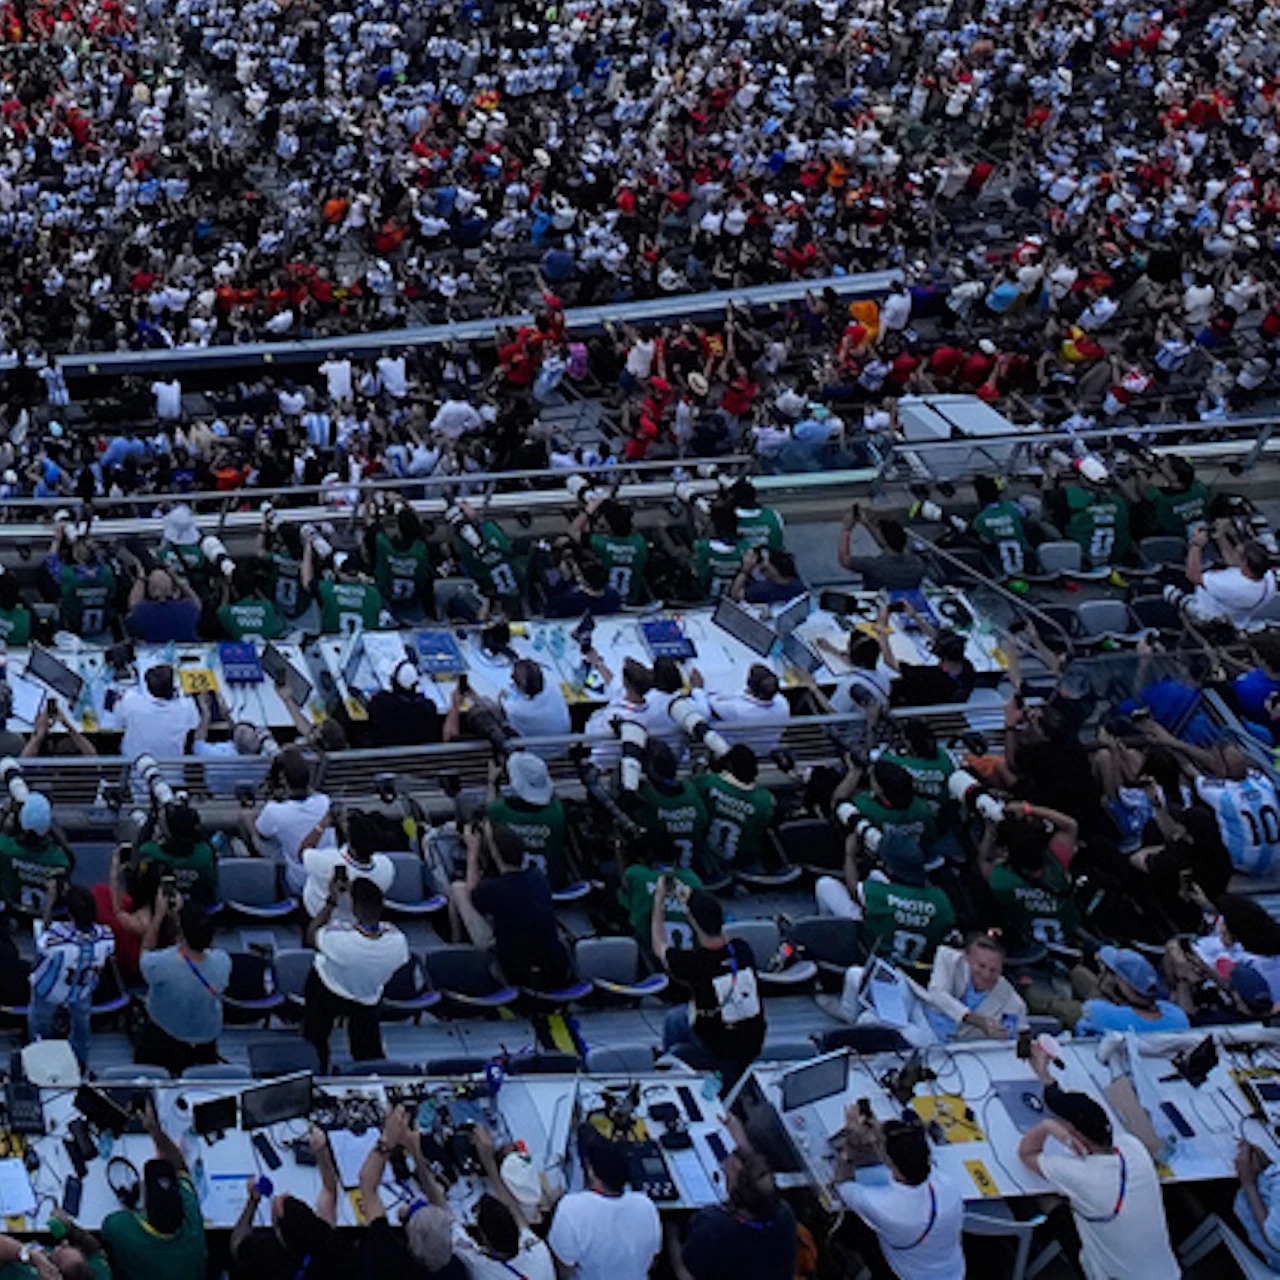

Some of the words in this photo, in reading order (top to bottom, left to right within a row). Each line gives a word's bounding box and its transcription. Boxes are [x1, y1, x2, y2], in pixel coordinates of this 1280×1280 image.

[657, 806, 697, 821] PHOTO
[1240, 806, 1280, 845] 10
[887, 894, 937, 917] PHOTO
